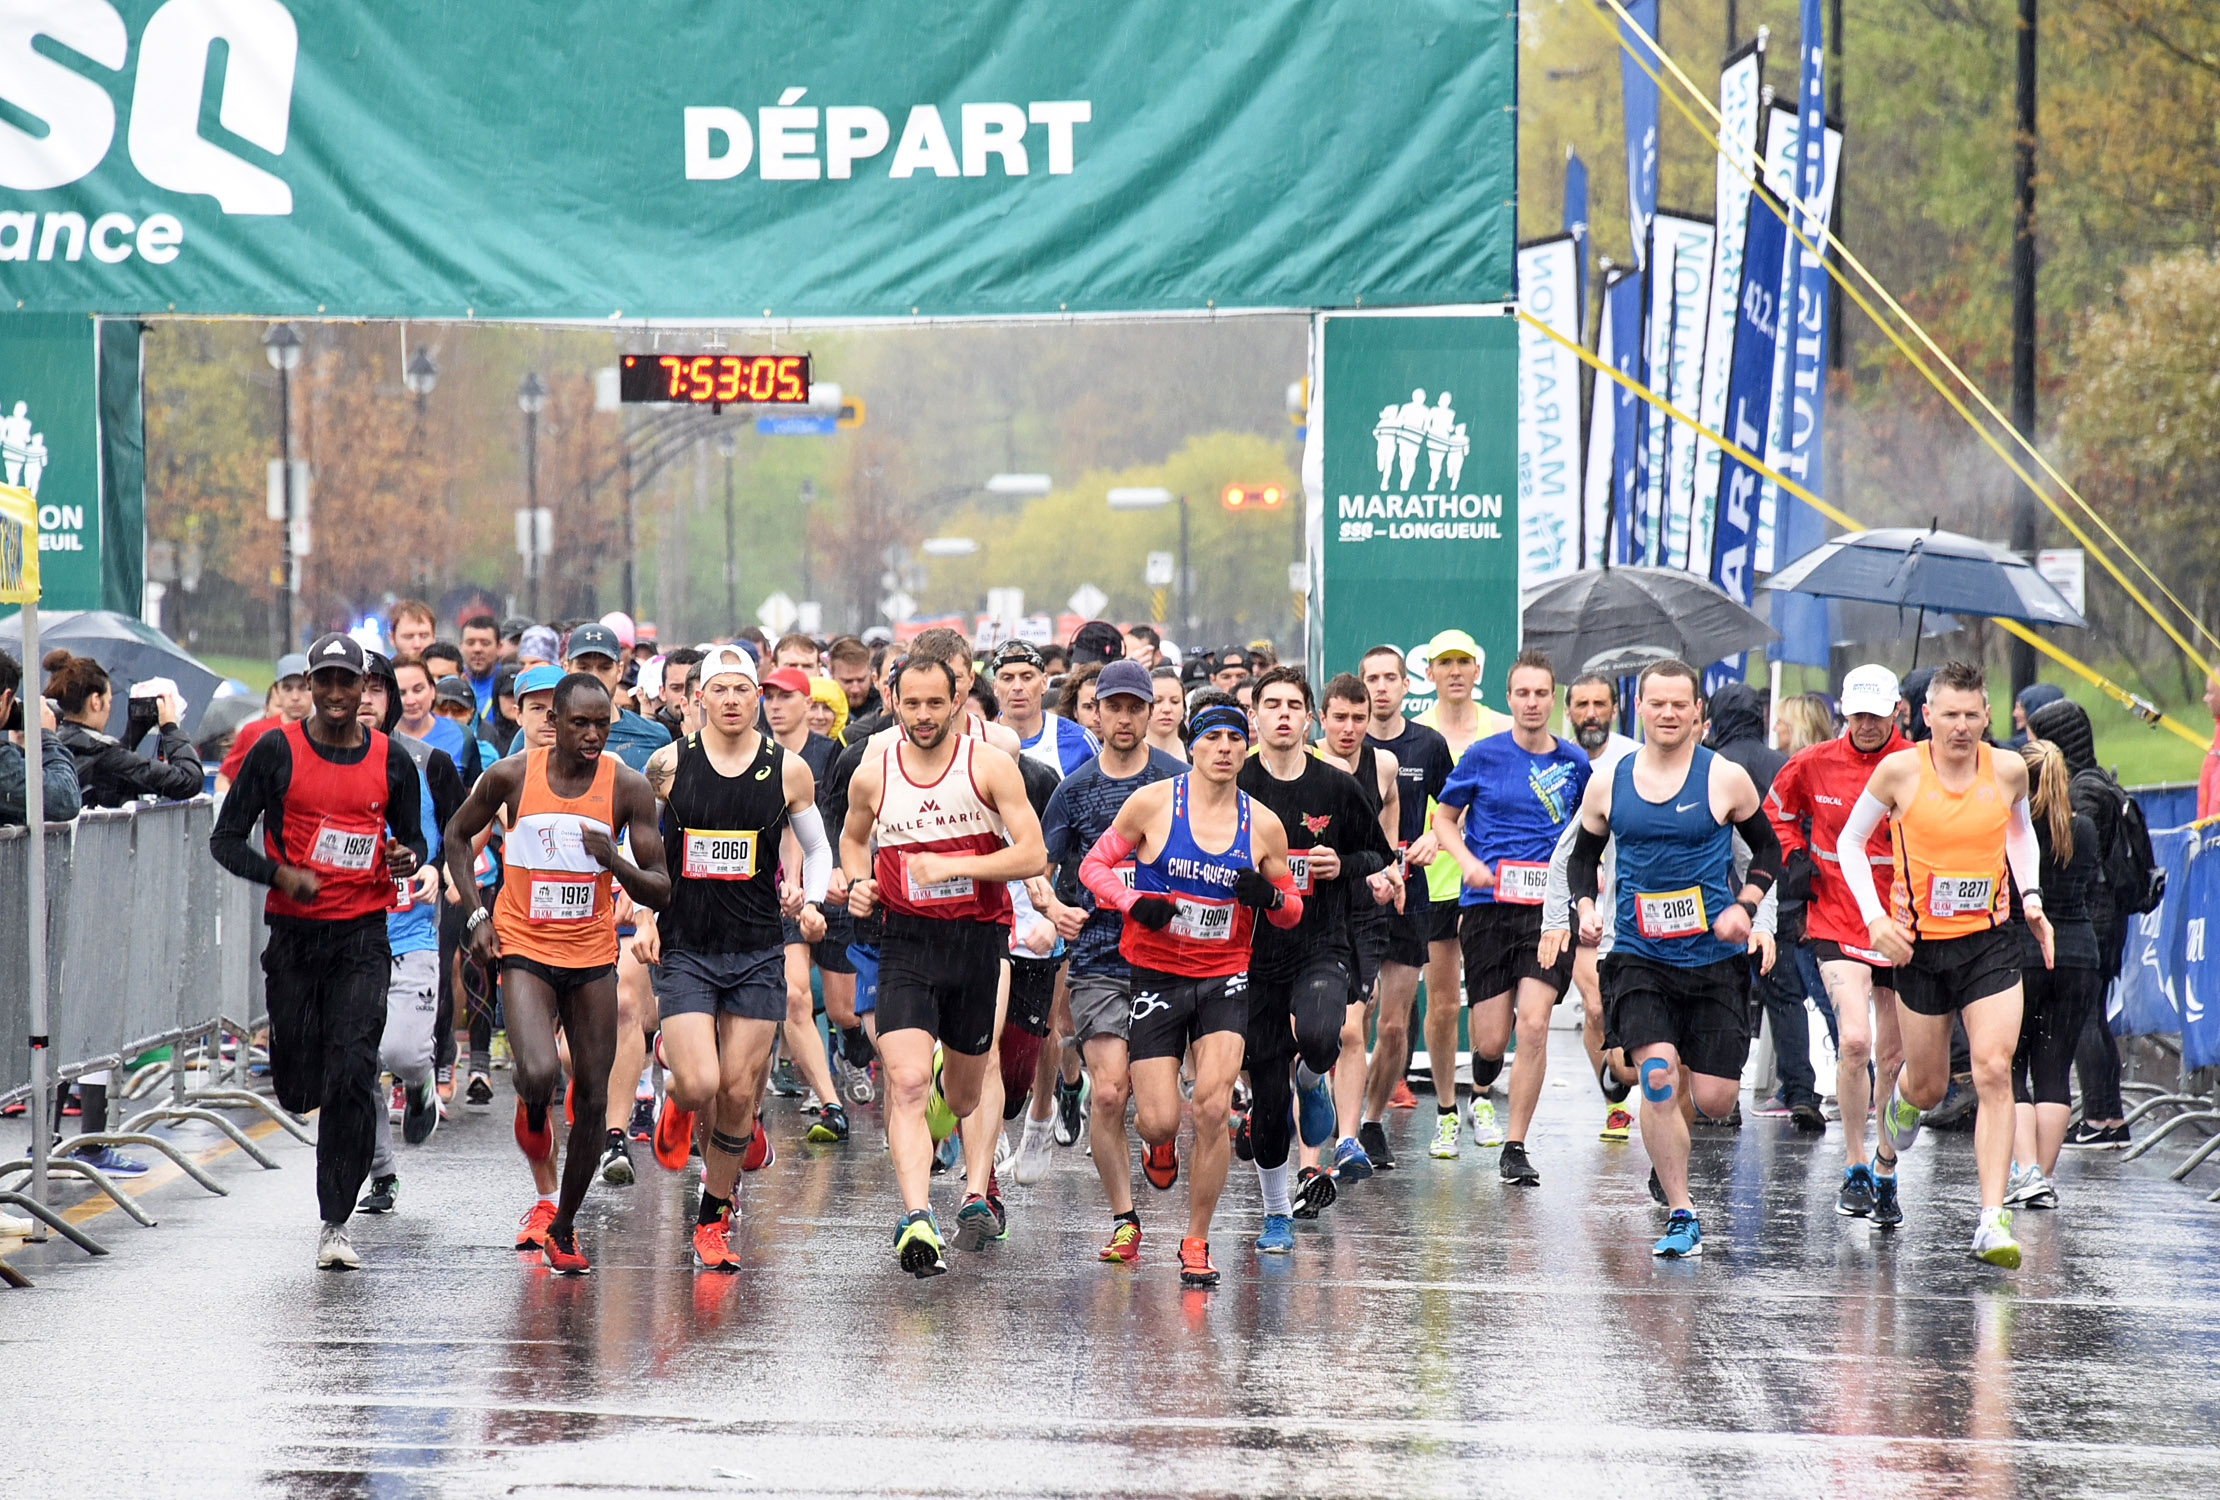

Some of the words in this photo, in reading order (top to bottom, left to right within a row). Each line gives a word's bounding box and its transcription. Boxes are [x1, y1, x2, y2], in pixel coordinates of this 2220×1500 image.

[684, 87, 1091, 180] DÉPART
[659, 356, 802, 400] 7:53:05
[1338, 494, 1503, 519] MARATHON
[712, 841, 748, 859] 2060
[1524, 870, 1548, 887] 1662
[561, 886, 590, 905] 1913
[1958, 881, 1988, 898] 2271
[1200, 907, 1228, 927] 1904
[1663, 898, 1694, 919] 2182
